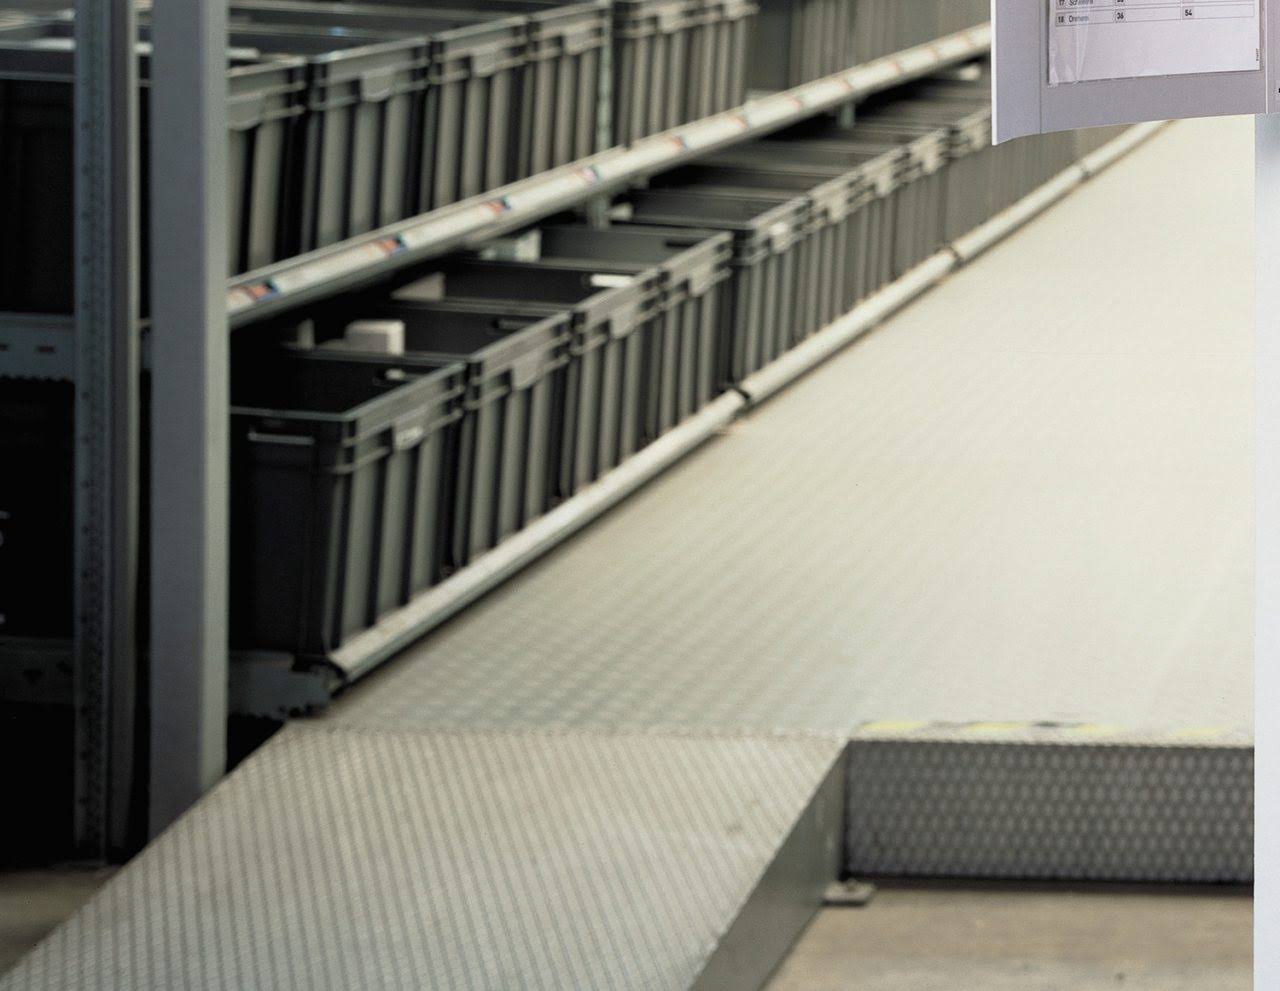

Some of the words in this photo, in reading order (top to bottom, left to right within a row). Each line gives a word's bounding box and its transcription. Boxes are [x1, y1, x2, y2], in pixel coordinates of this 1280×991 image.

[1116, 12, 1125, 20] 36
[1184, 9, 1193, 17] 54
[1057, 15, 1065, 24] 18
